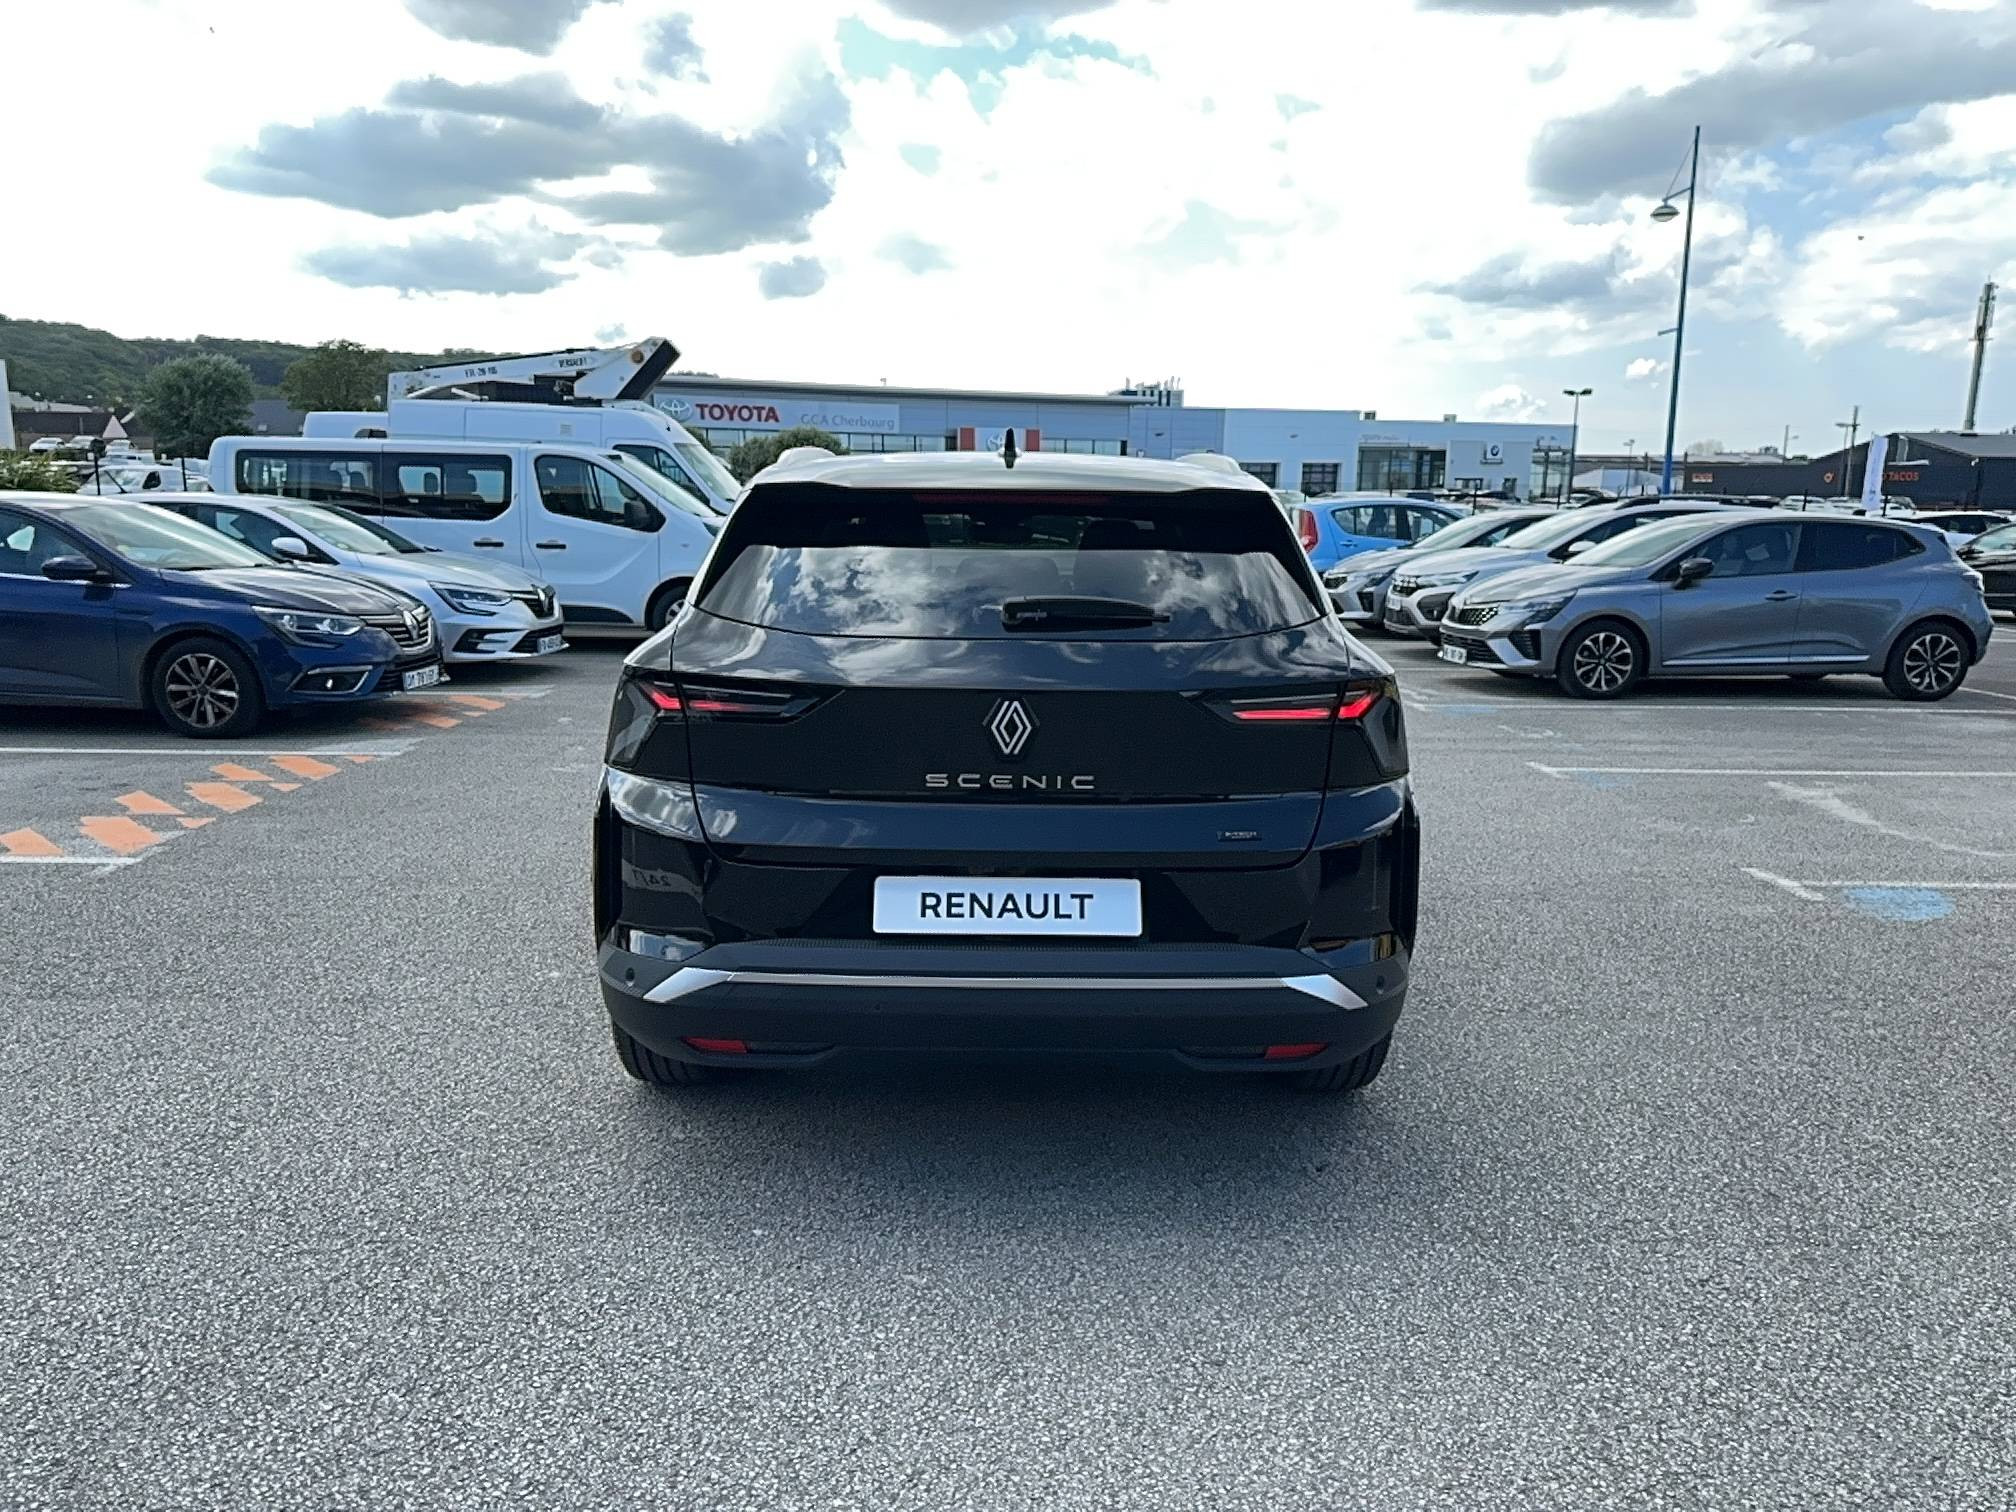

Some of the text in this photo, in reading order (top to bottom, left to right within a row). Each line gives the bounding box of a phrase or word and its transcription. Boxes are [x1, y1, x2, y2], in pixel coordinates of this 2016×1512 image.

[695, 404, 780, 423] TOYOTA
[831, 414, 896, 431] Cherbourg
[925, 773, 1096, 790] SCENIC
[920, 892, 1094, 919] RENAULT
